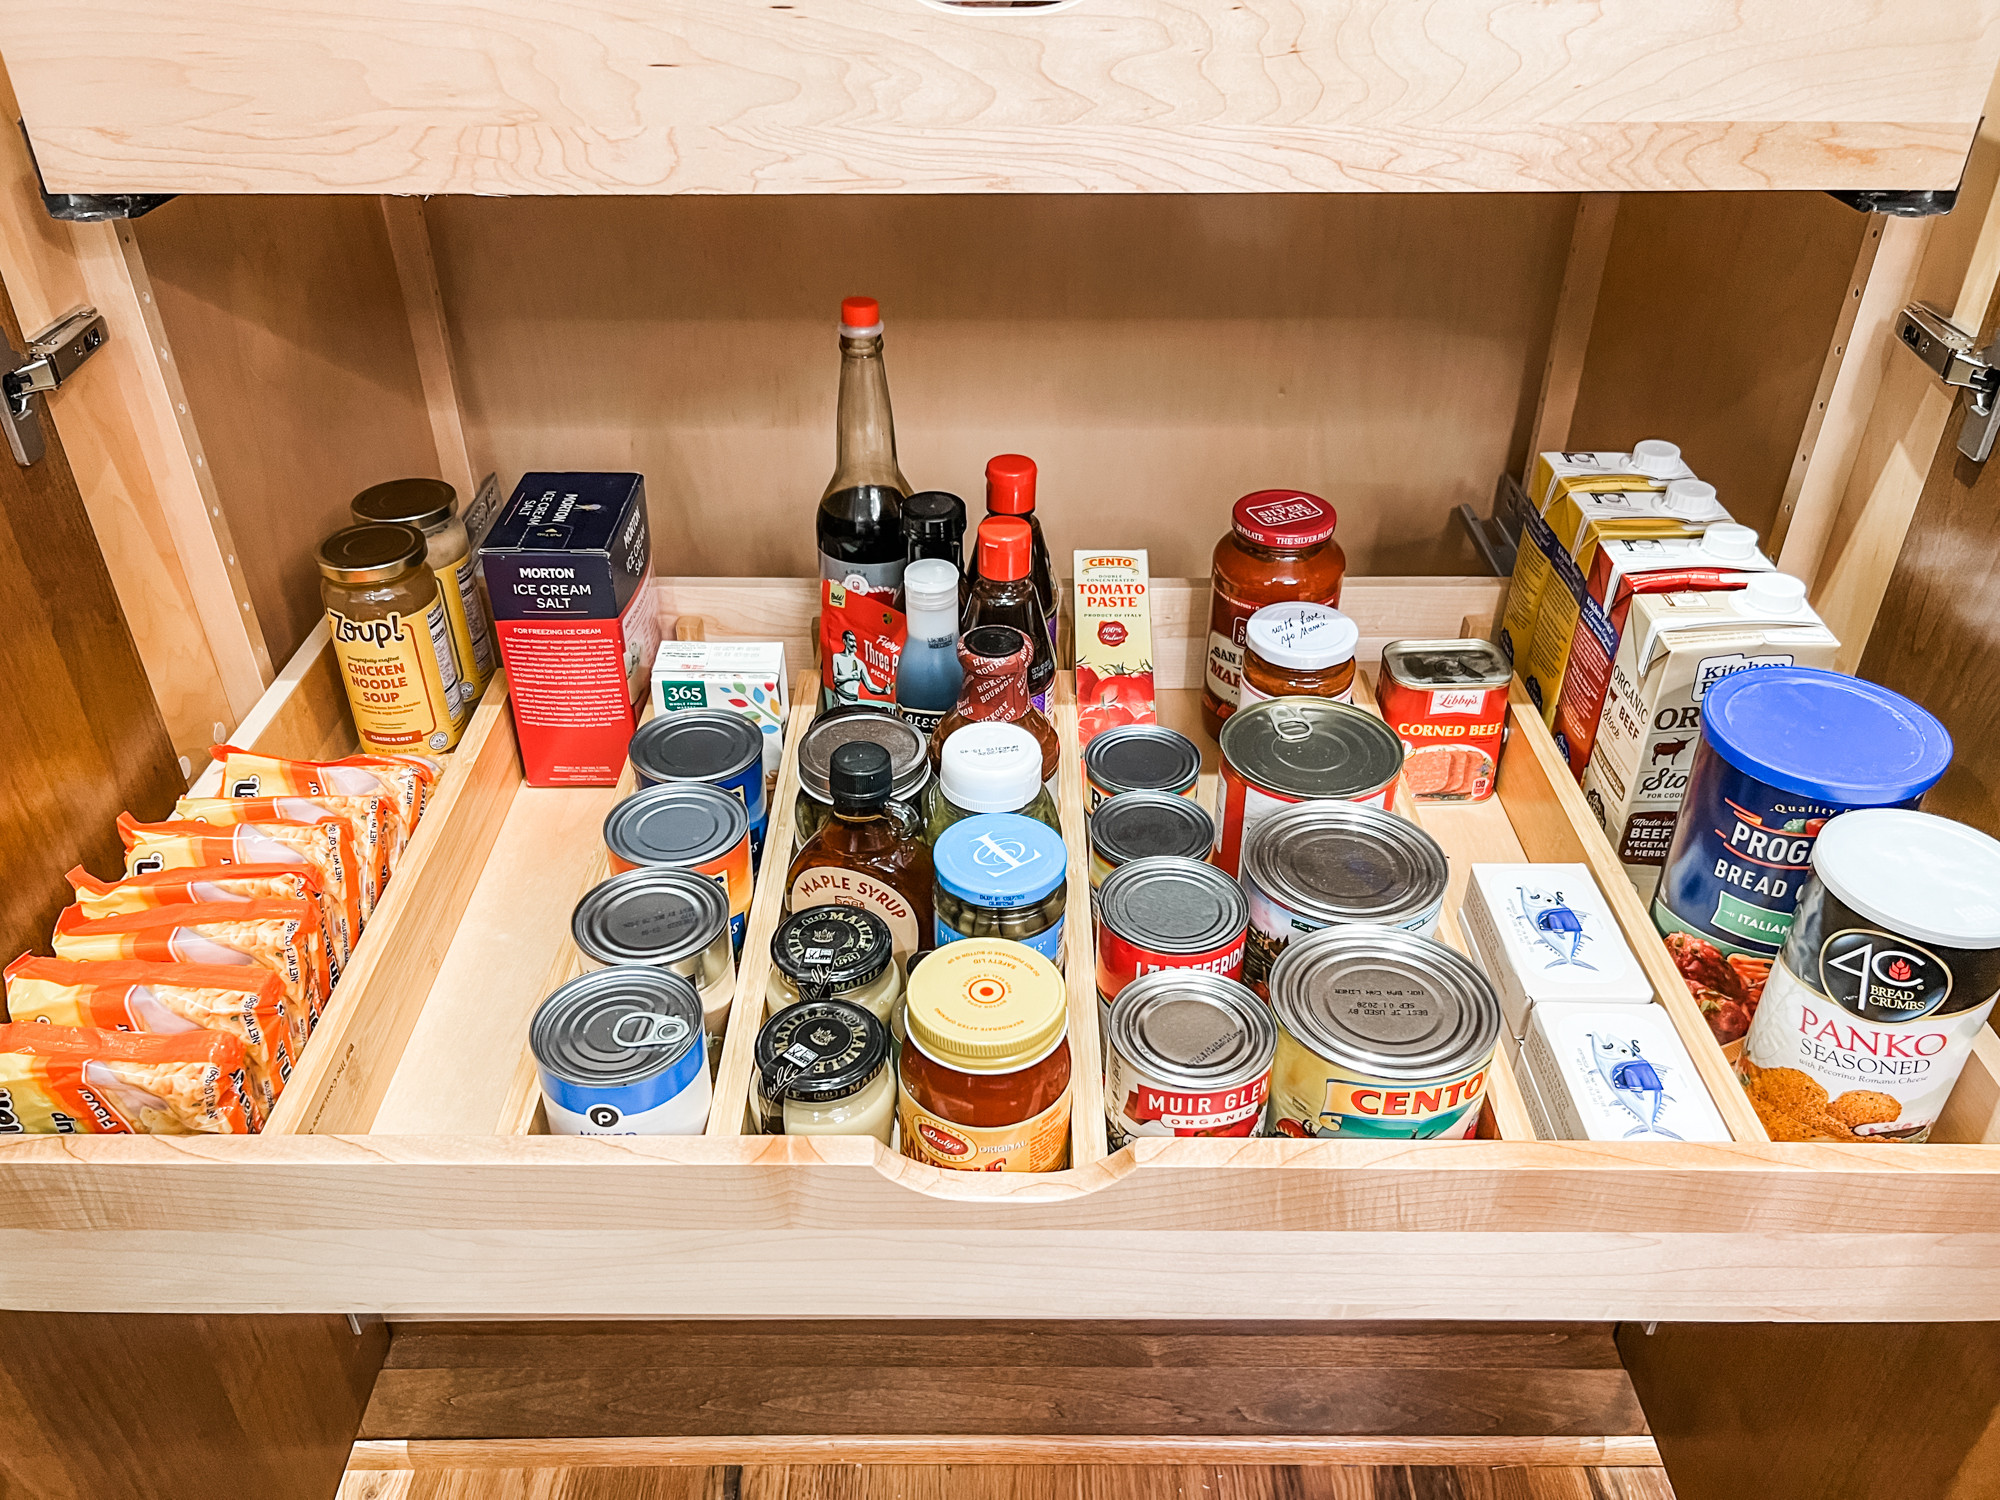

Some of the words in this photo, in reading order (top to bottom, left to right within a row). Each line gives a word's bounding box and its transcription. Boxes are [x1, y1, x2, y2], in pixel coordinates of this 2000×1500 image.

[518, 499, 537, 517] SALT
[527, 501, 550, 526] CREAM
[552, 493, 579, 523] MORTON
[1257, 503, 1308, 517] SILVER
[623, 505, 641, 550] MORTON
[1275, 536, 1293, 545] THE
[1293, 534, 1317, 545] SILVER
[635, 549, 646, 576] SALT
[1088, 557, 1133, 567] CENTO
[519, 567, 575, 579] MORTON
[513, 583, 538, 596] ICE
[540, 583, 592, 596] CREAM
[1077, 583, 1146, 595] TOMATO
[536, 597, 571, 609] SALT
[1086, 596, 1138, 608] PASTE
[329, 610, 405, 649] Zoup!
[529, 628, 563, 636] FREEZING
[876, 633, 901, 654] Fiery
[863, 639, 890, 673] Three
[347, 662, 406, 676] CHICKEN
[870, 667, 891, 684] PICKLE
[351, 675, 408, 690] NOODLE
[362, 691, 400, 703] SOUP
[667, 685, 702, 702] 365
[1437, 693, 1479, 709] Libby's
[1613, 664, 1649, 725] ORGANIC
[1397, 722, 1466, 737] CORNED
[1468, 721, 1502, 737] BEEF
[1602, 706, 1620, 741] Stock
[1618, 704, 1640, 741] BEEF
[1638, 767, 1688, 795] Sto
[1774, 803, 1837, 816] Quality
[1632, 818, 1661, 827] Made
[1627, 840, 1669, 849] VEGETA
[1731, 821, 1812, 865] PROG
[1634, 849, 1666, 857] HERBS
[1713, 858, 1788, 899] BREAD
[799, 875, 851, 898] MAPLE
[857, 881, 907, 920] SYRUP
[829, 911, 874, 952] MAILLE
[988, 958, 1017, 970] SAFETY
[1826, 943, 1926, 1011] 4C
[1869, 984, 1915, 1001] BREAD
[1869, 994, 1926, 1011] CRUMBS
[1798, 1004, 1948, 1059] PANKO
[1799, 1037, 1931, 1075] SEASONED
[1799, 1057, 1815, 1070] with
[1817, 1064, 1856, 1081] Pecorino
[1858, 1075, 1897, 1085] Romano
[1898, 1074, 1929, 1085] Cheese
[1148, 1093, 1212, 1114] MUIR
[1225, 1076, 1269, 1110] GLEN
[1351, 1071, 1484, 1116] CENTO
[77, 1088, 118, 1130] Flavor
[1170, 1107, 1253, 1126] ORGANIC
[923, 1129, 963, 1150] Isaly's
[979, 1140, 1029, 1154] ORIGINAL
